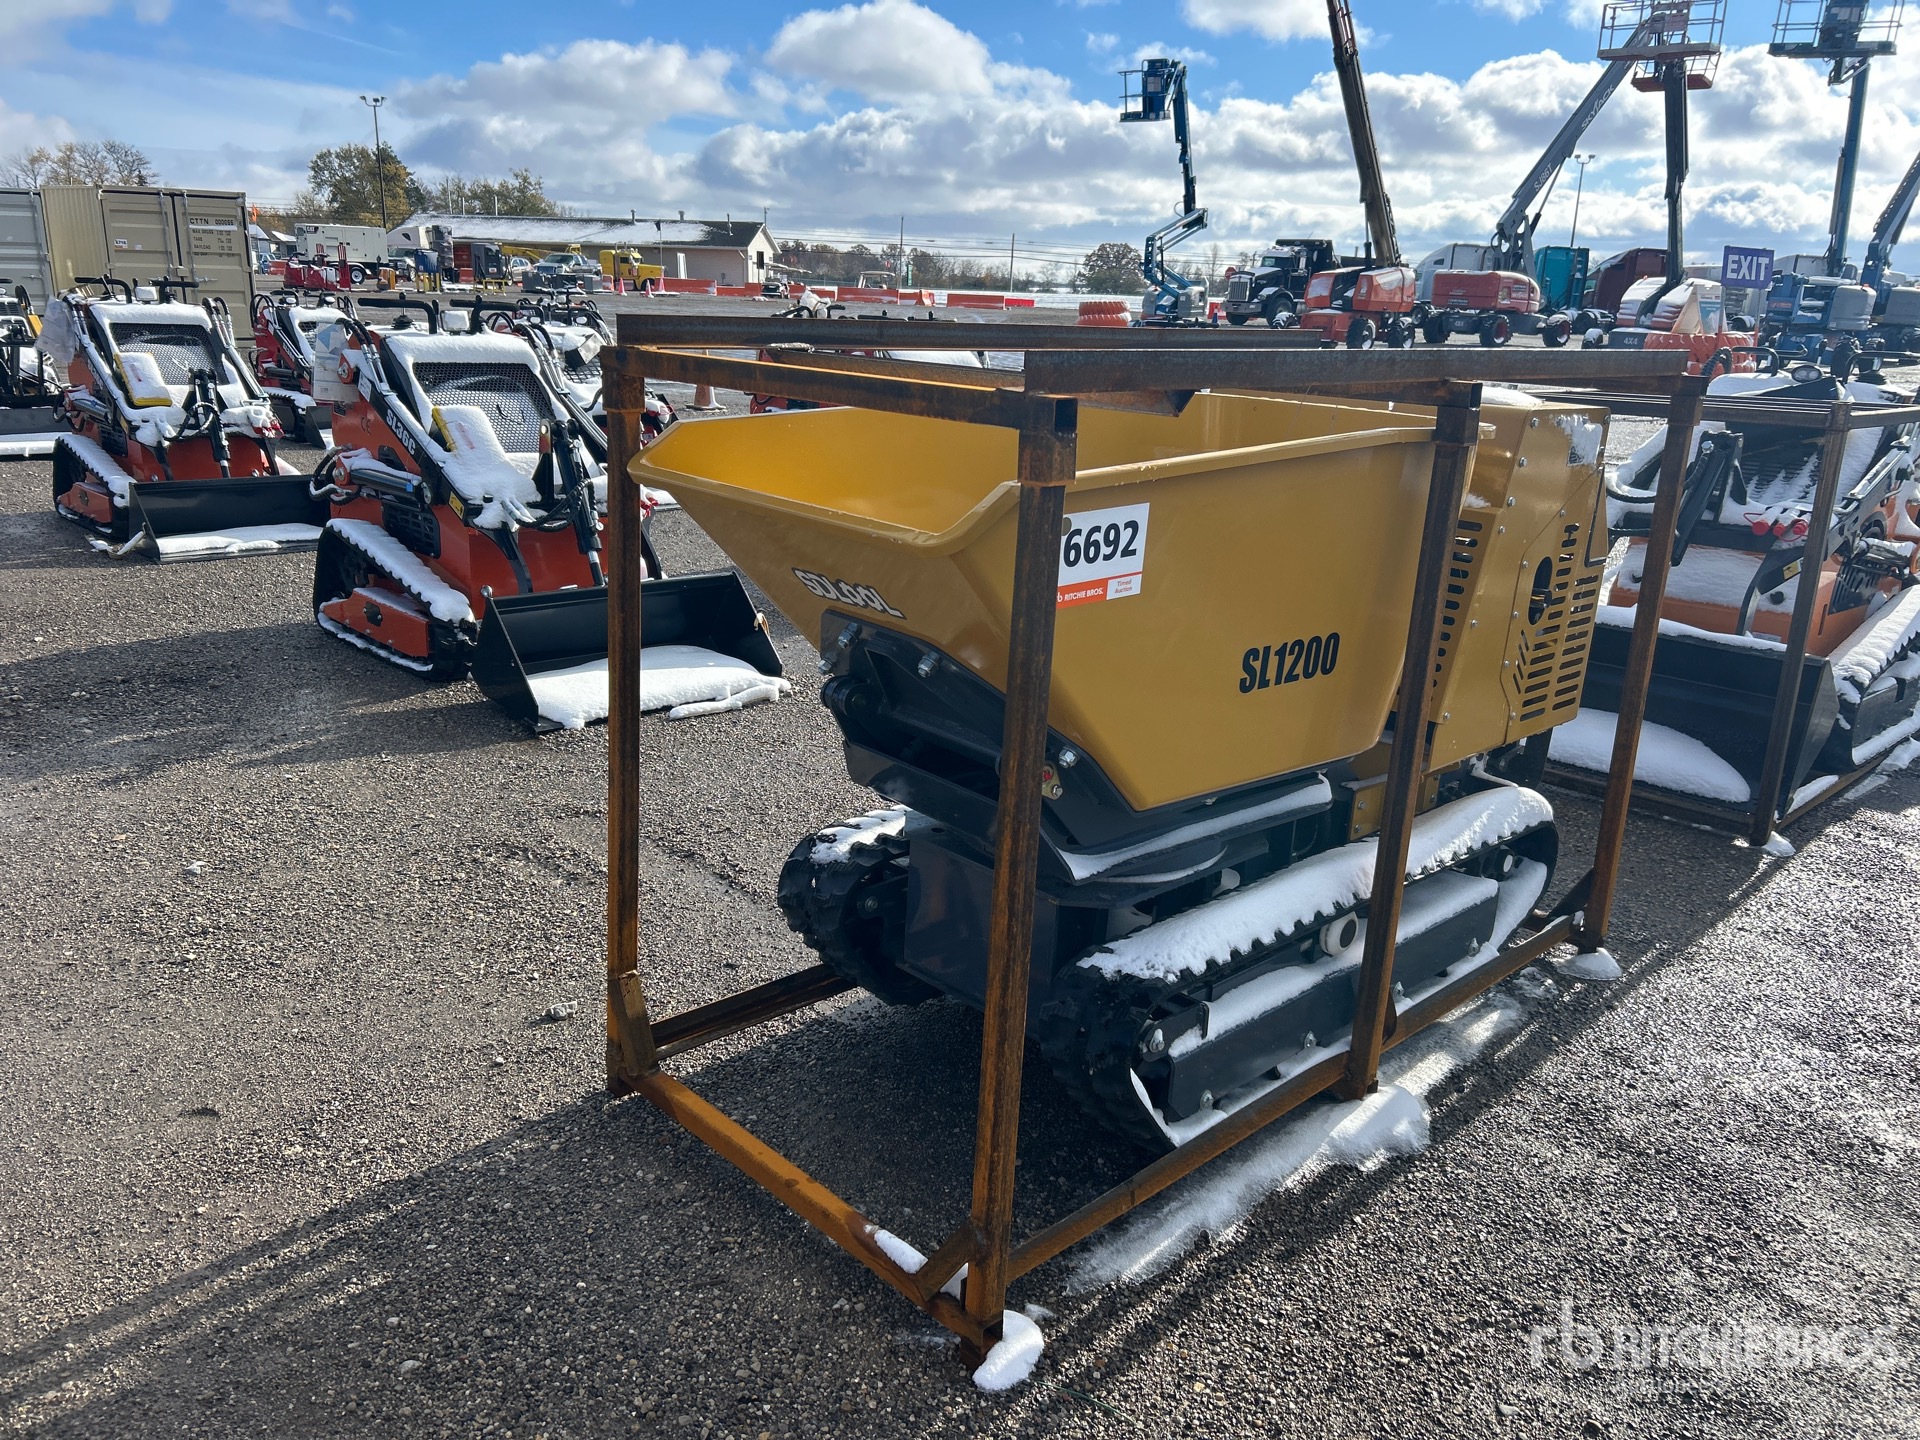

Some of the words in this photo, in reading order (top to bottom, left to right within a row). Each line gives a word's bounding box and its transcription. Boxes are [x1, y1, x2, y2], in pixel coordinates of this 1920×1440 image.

[1581, 84, 1615, 130] SKYJACK
[1533, 162, 1553, 192] SJ86T
[189, 217, 209, 225] CTTN
[1726, 254, 1770, 281] EXIT
[1623, 337, 1638, 345] 4X4
[386, 408, 416, 456] SL36C
[1063, 519, 1139, 568] 6692
[1064, 590, 1086, 602] RITCHIE
[1114, 585, 1132, 594] Auction
[1117, 579, 1132, 587] Timed
[1238, 632, 1340, 695] SL1200
